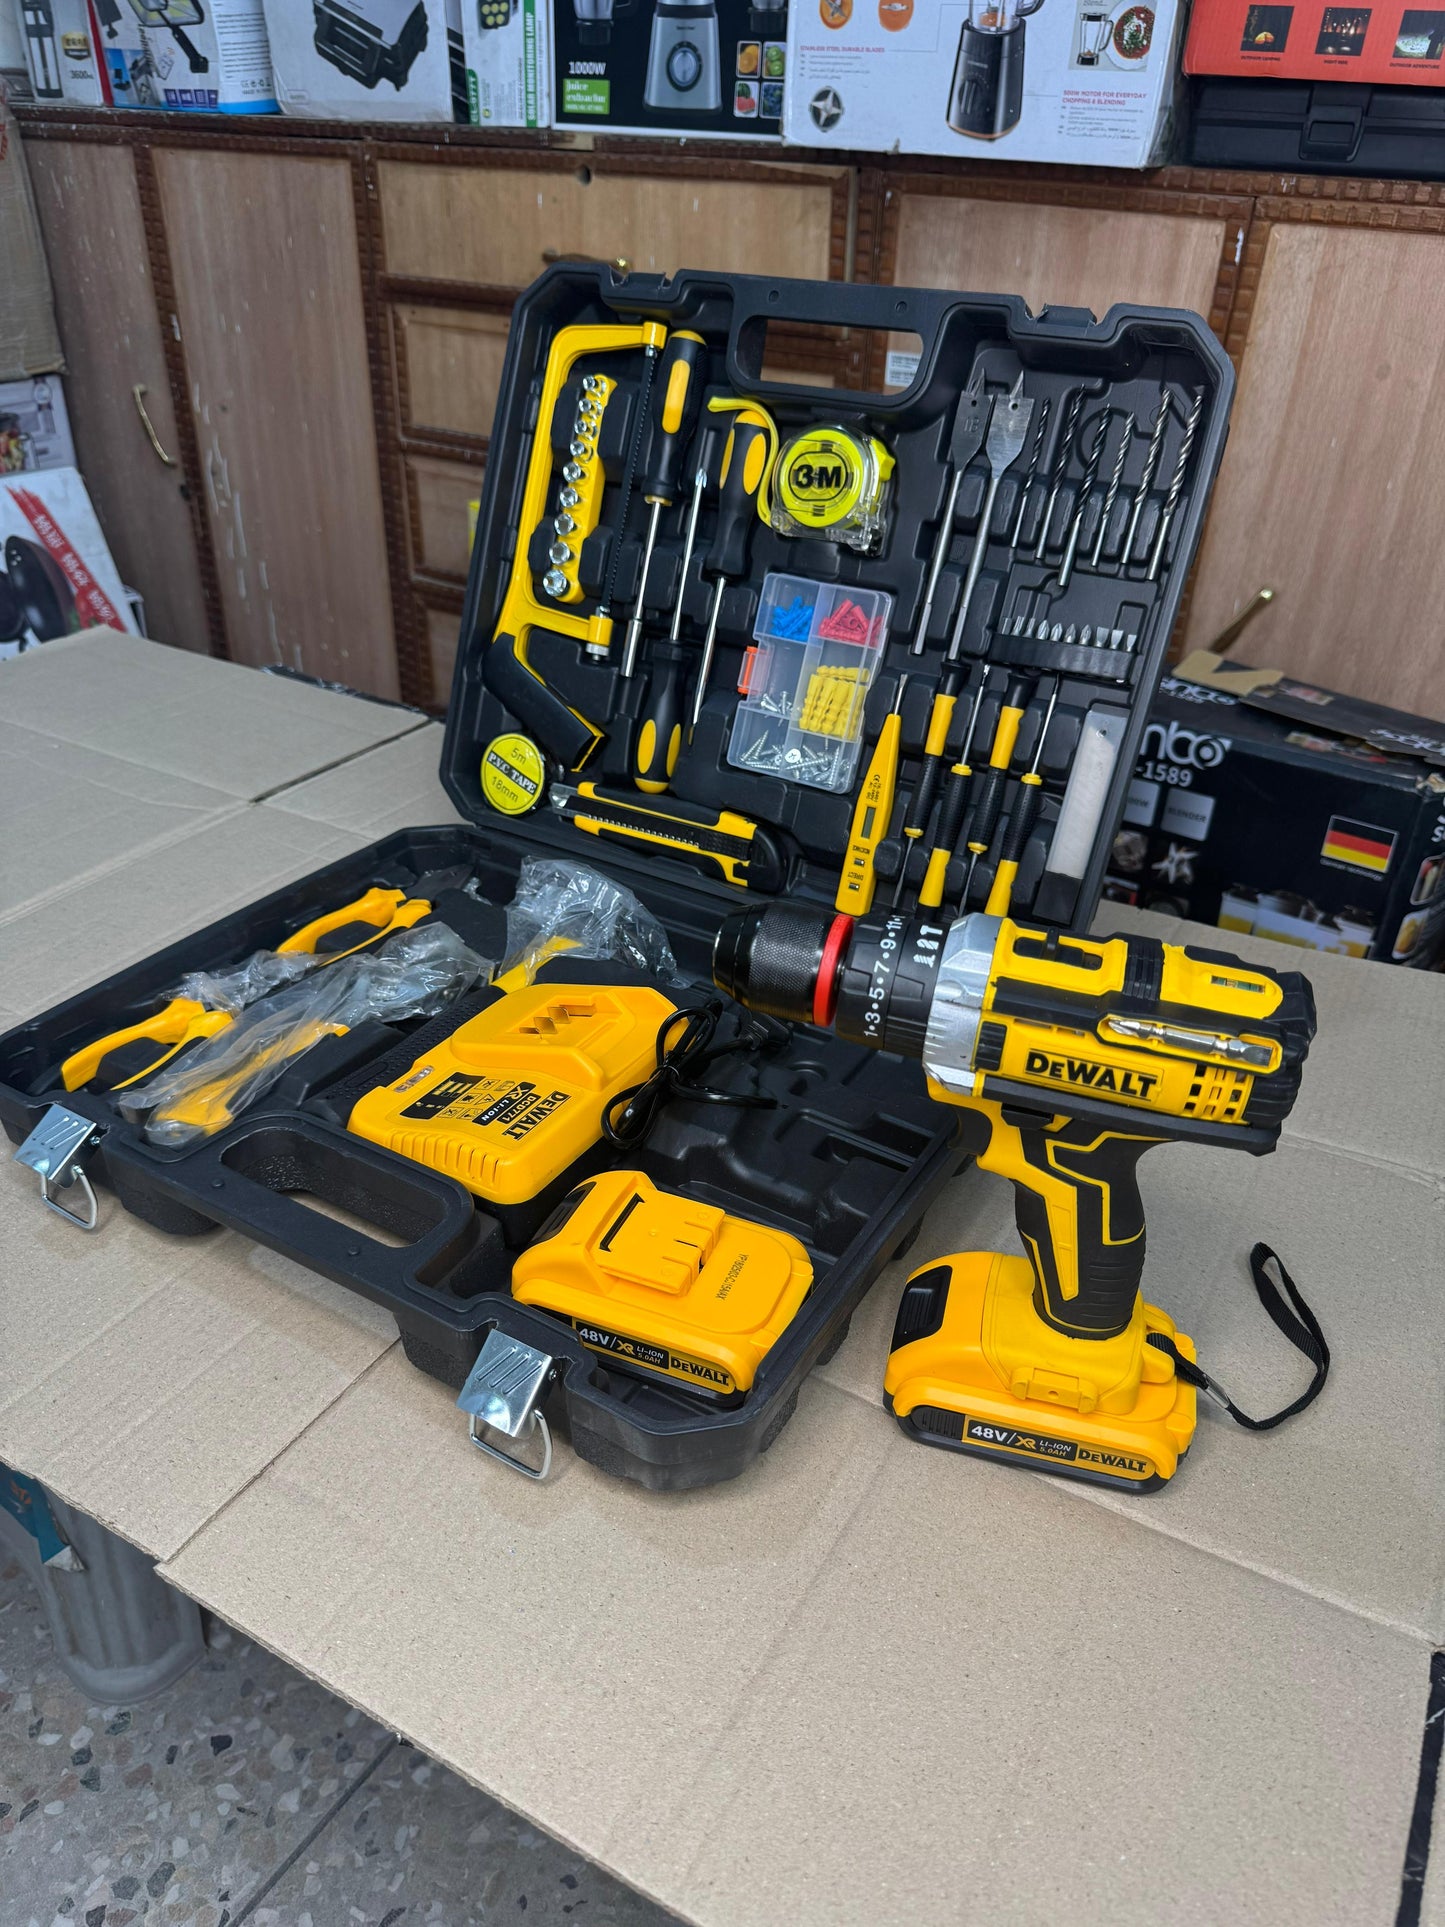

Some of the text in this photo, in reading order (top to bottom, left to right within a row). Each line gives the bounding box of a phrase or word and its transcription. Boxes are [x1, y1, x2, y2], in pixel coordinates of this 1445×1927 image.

[525, 12, 536, 121] SOLAR MONITORING LAMP
[568, 61, 606, 75] 1000W
[795, 464, 842, 489] 3M
[510, 747, 527, 764] 5m
[511, 769, 537, 794] TAPE
[1025, 1051, 1157, 1098] DEWALT
[481, 1099, 509, 1121] LI-ION
[502, 1095, 537, 1121] DCD771
[502, 1091, 570, 1140] DEWALT
[636, 1345, 664, 1359] LI-ION
[637, 1352, 661, 1364] 5.0AH
[671, 1356, 729, 1386] DEWALT
[1039, 1439, 1072, 1452] LI-ION
[1039, 1446, 1067, 1457] 5.0AH
[1078, 1448, 1147, 1473] DEWALT
